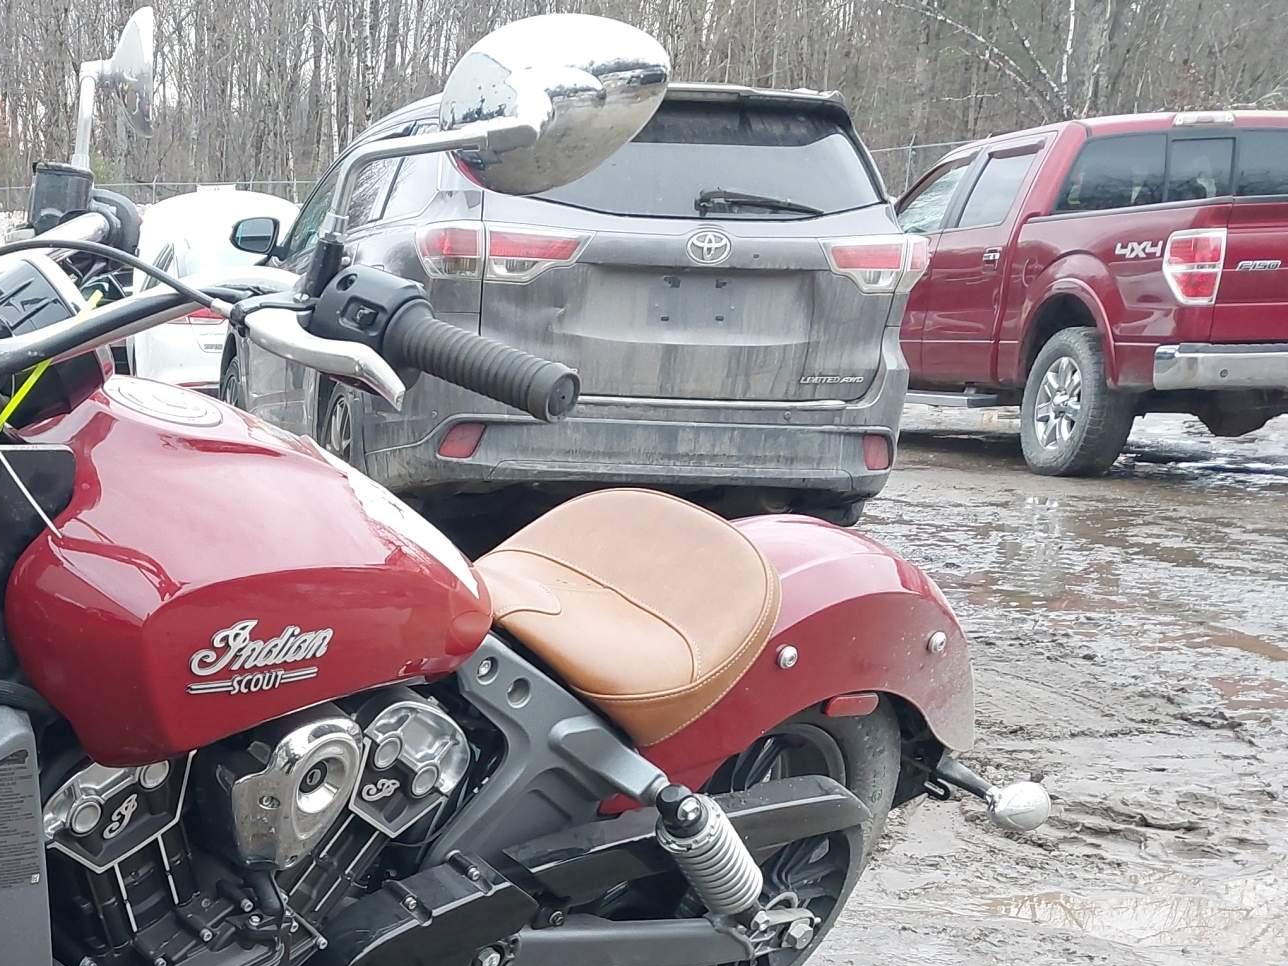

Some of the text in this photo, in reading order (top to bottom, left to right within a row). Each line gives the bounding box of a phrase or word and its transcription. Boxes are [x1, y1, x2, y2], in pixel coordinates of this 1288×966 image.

[799, 375, 865, 385] LIMITED AWD
[190, 619, 333, 677] Indian
[230, 669, 285, 695] SCOUT
